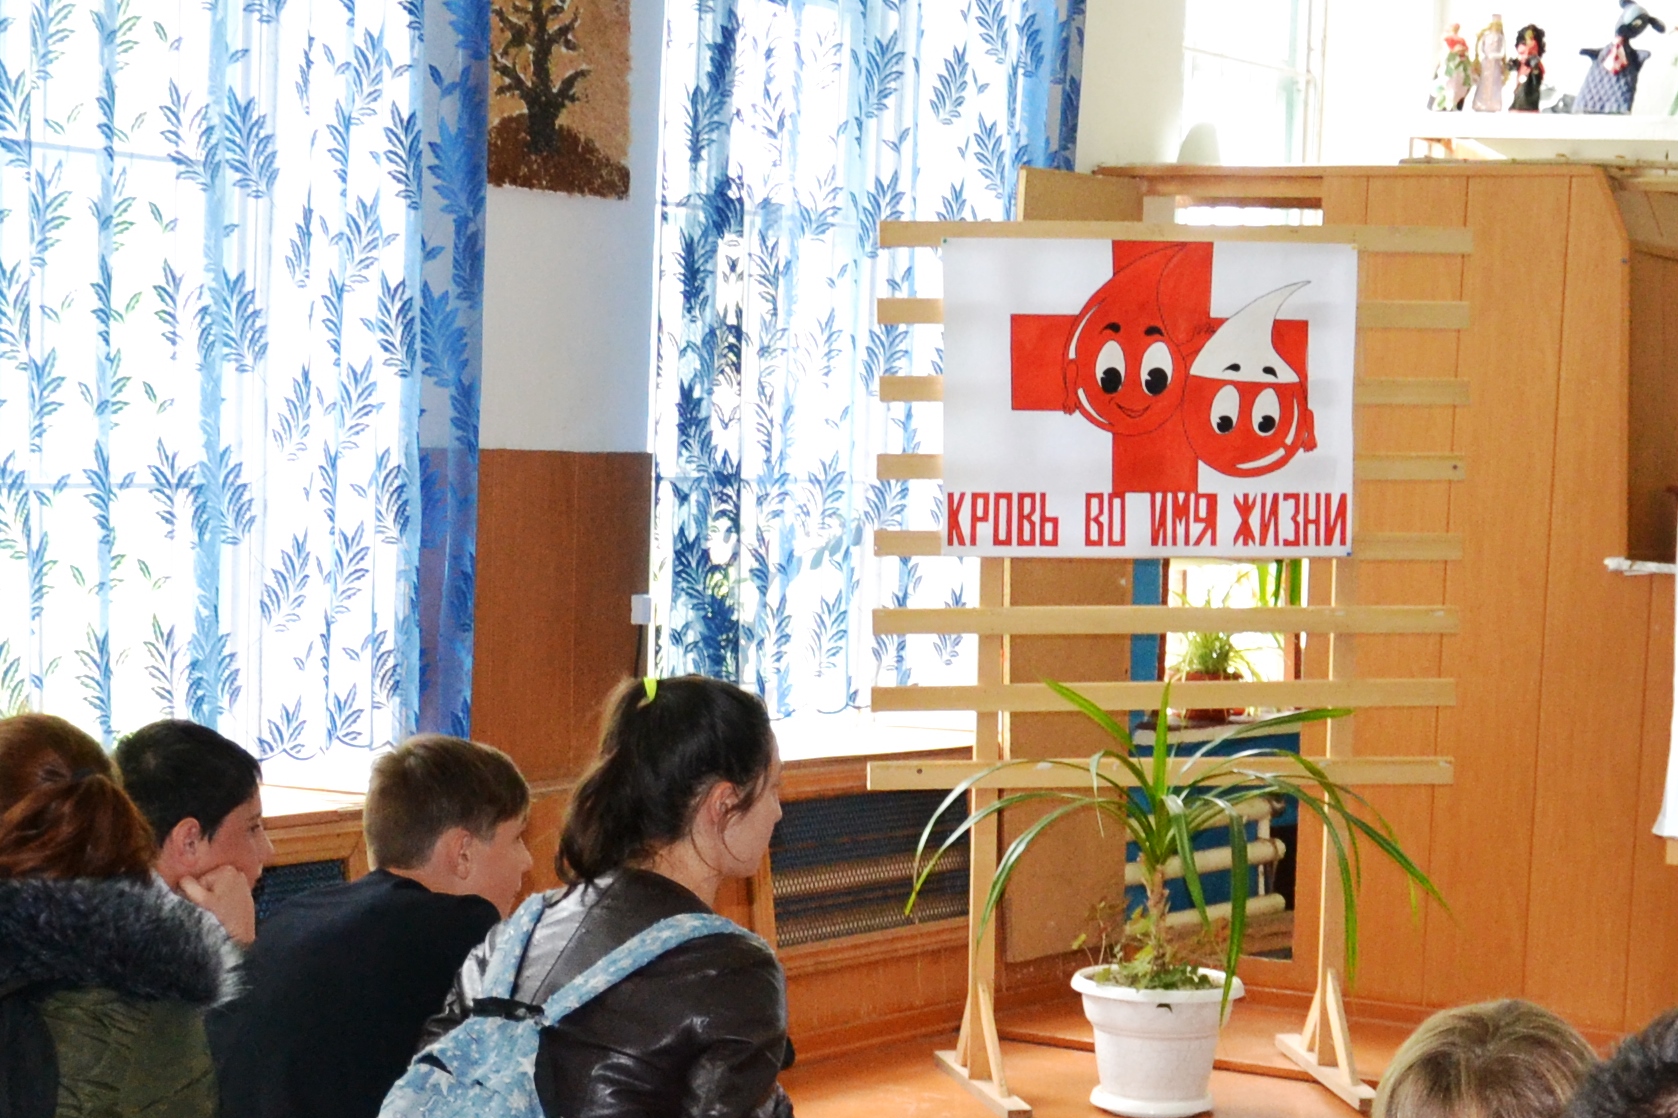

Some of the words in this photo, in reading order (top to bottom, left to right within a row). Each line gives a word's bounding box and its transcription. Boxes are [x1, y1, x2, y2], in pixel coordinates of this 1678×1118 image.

[947, 492, 1058, 546] КРОВЬ
[1085, 493, 1126, 546] ВО
[1150, 493, 1218, 546] ИМЯ
[1233, 493, 1347, 546] ЖИЗНИ
